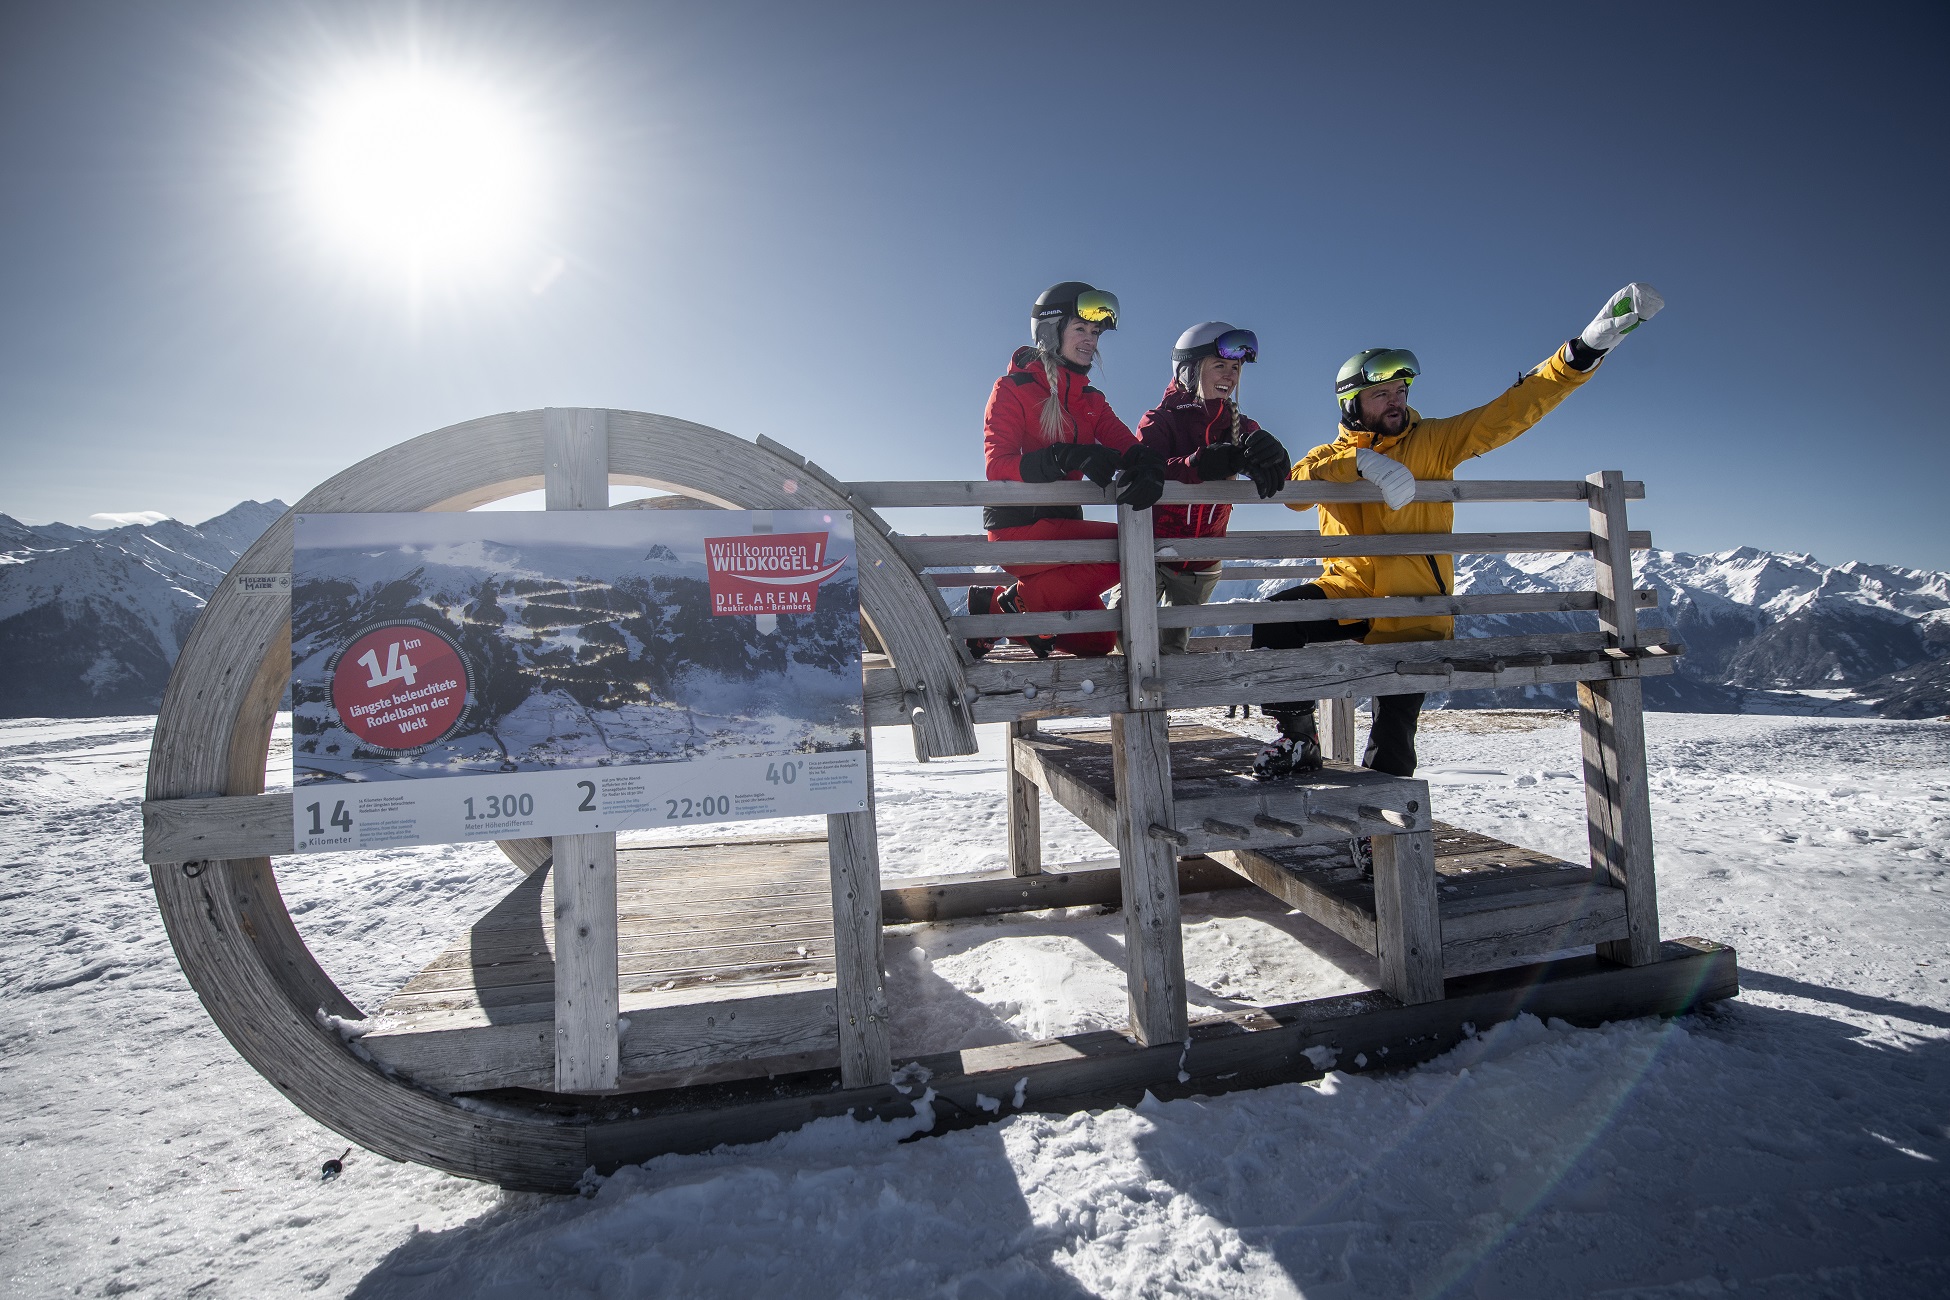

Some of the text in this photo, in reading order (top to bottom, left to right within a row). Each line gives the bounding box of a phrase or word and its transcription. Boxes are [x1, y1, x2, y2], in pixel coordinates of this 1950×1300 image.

[710, 543, 806, 556] Willkommen
[716, 592, 810, 604] DIE ARENA
[716, 603, 812, 612] Neukirchen Bramberg
[358, 638, 422, 688] 14 km
[350, 678, 458, 718] längste beleuchtete
[366, 696, 450, 728] Rodelbahn der
[398, 718, 428, 734] Welt
[464, 793, 534, 820] 1.300
[576, 780, 596, 812] 2
[666, 795, 730, 819] 22:00
[306, 800, 353, 834] 14
[486, 820, 533, 828] Höhendifferenz
[309, 837, 352, 846] Kilometer
